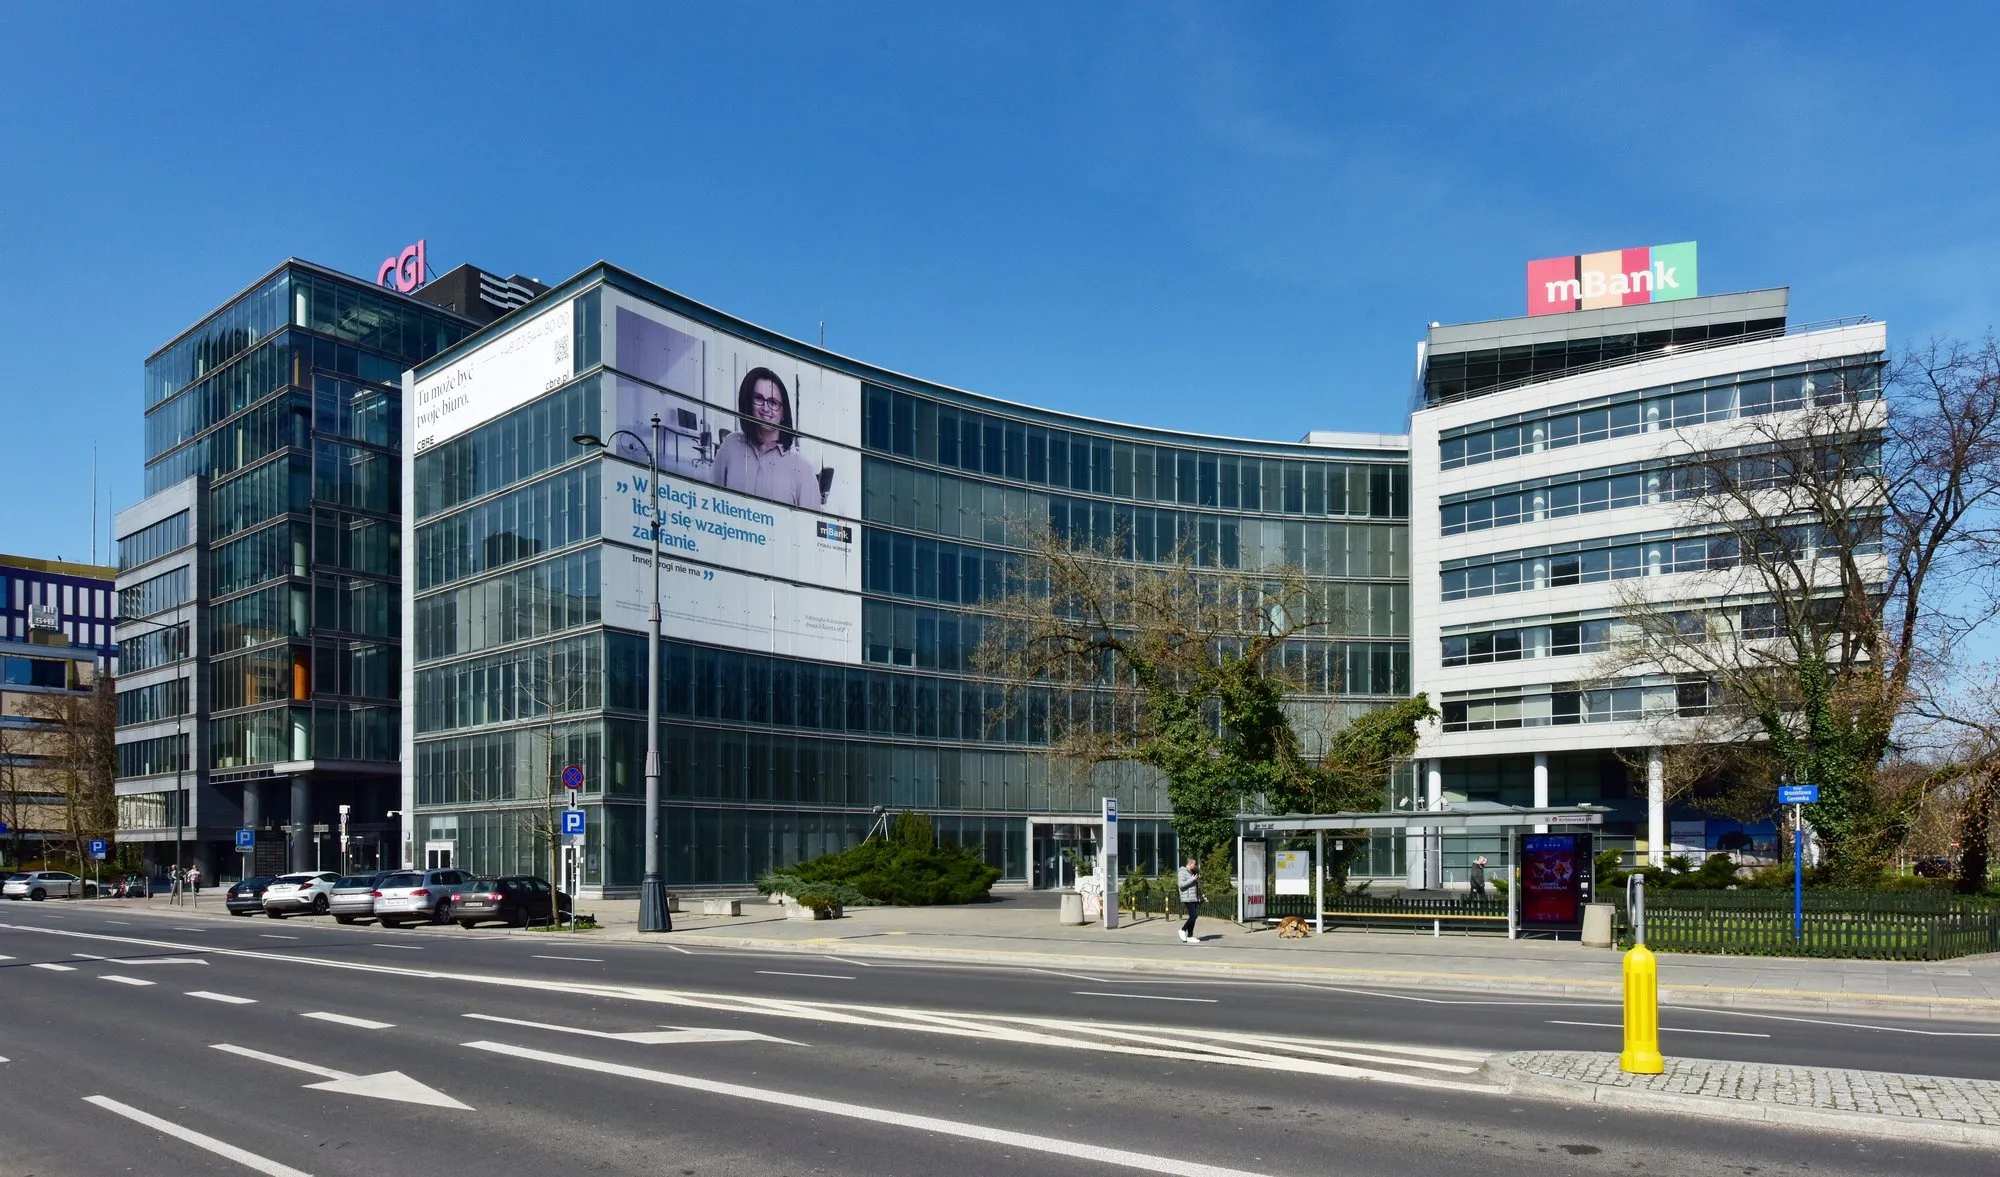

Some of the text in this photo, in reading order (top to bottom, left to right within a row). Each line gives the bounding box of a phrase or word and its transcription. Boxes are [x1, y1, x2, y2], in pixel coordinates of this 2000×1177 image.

[377, 239, 427, 293] CGI
[1546, 260, 1680, 303] mBank
[417, 362, 475, 406] Tu może być
[545, 369, 570, 391] cbre.pl
[417, 393, 470, 428] twoje biuro.
[416, 435, 434, 451] CBRE
[656, 483, 697, 510] elacji
[701, 498, 709, 510] z
[712, 496, 774, 527] klientem
[632, 525, 699, 552] zafanie.
[670, 510, 692, 532] się
[695, 517, 766, 546] wzajemne
[820, 526, 849, 540] mBank
[632, 554, 652, 568] Innej
[657, 559, 673, 572] rogi
[675, 564, 687, 575] nie
[567, 814, 580, 832] P
[240, 831, 251, 845] P
